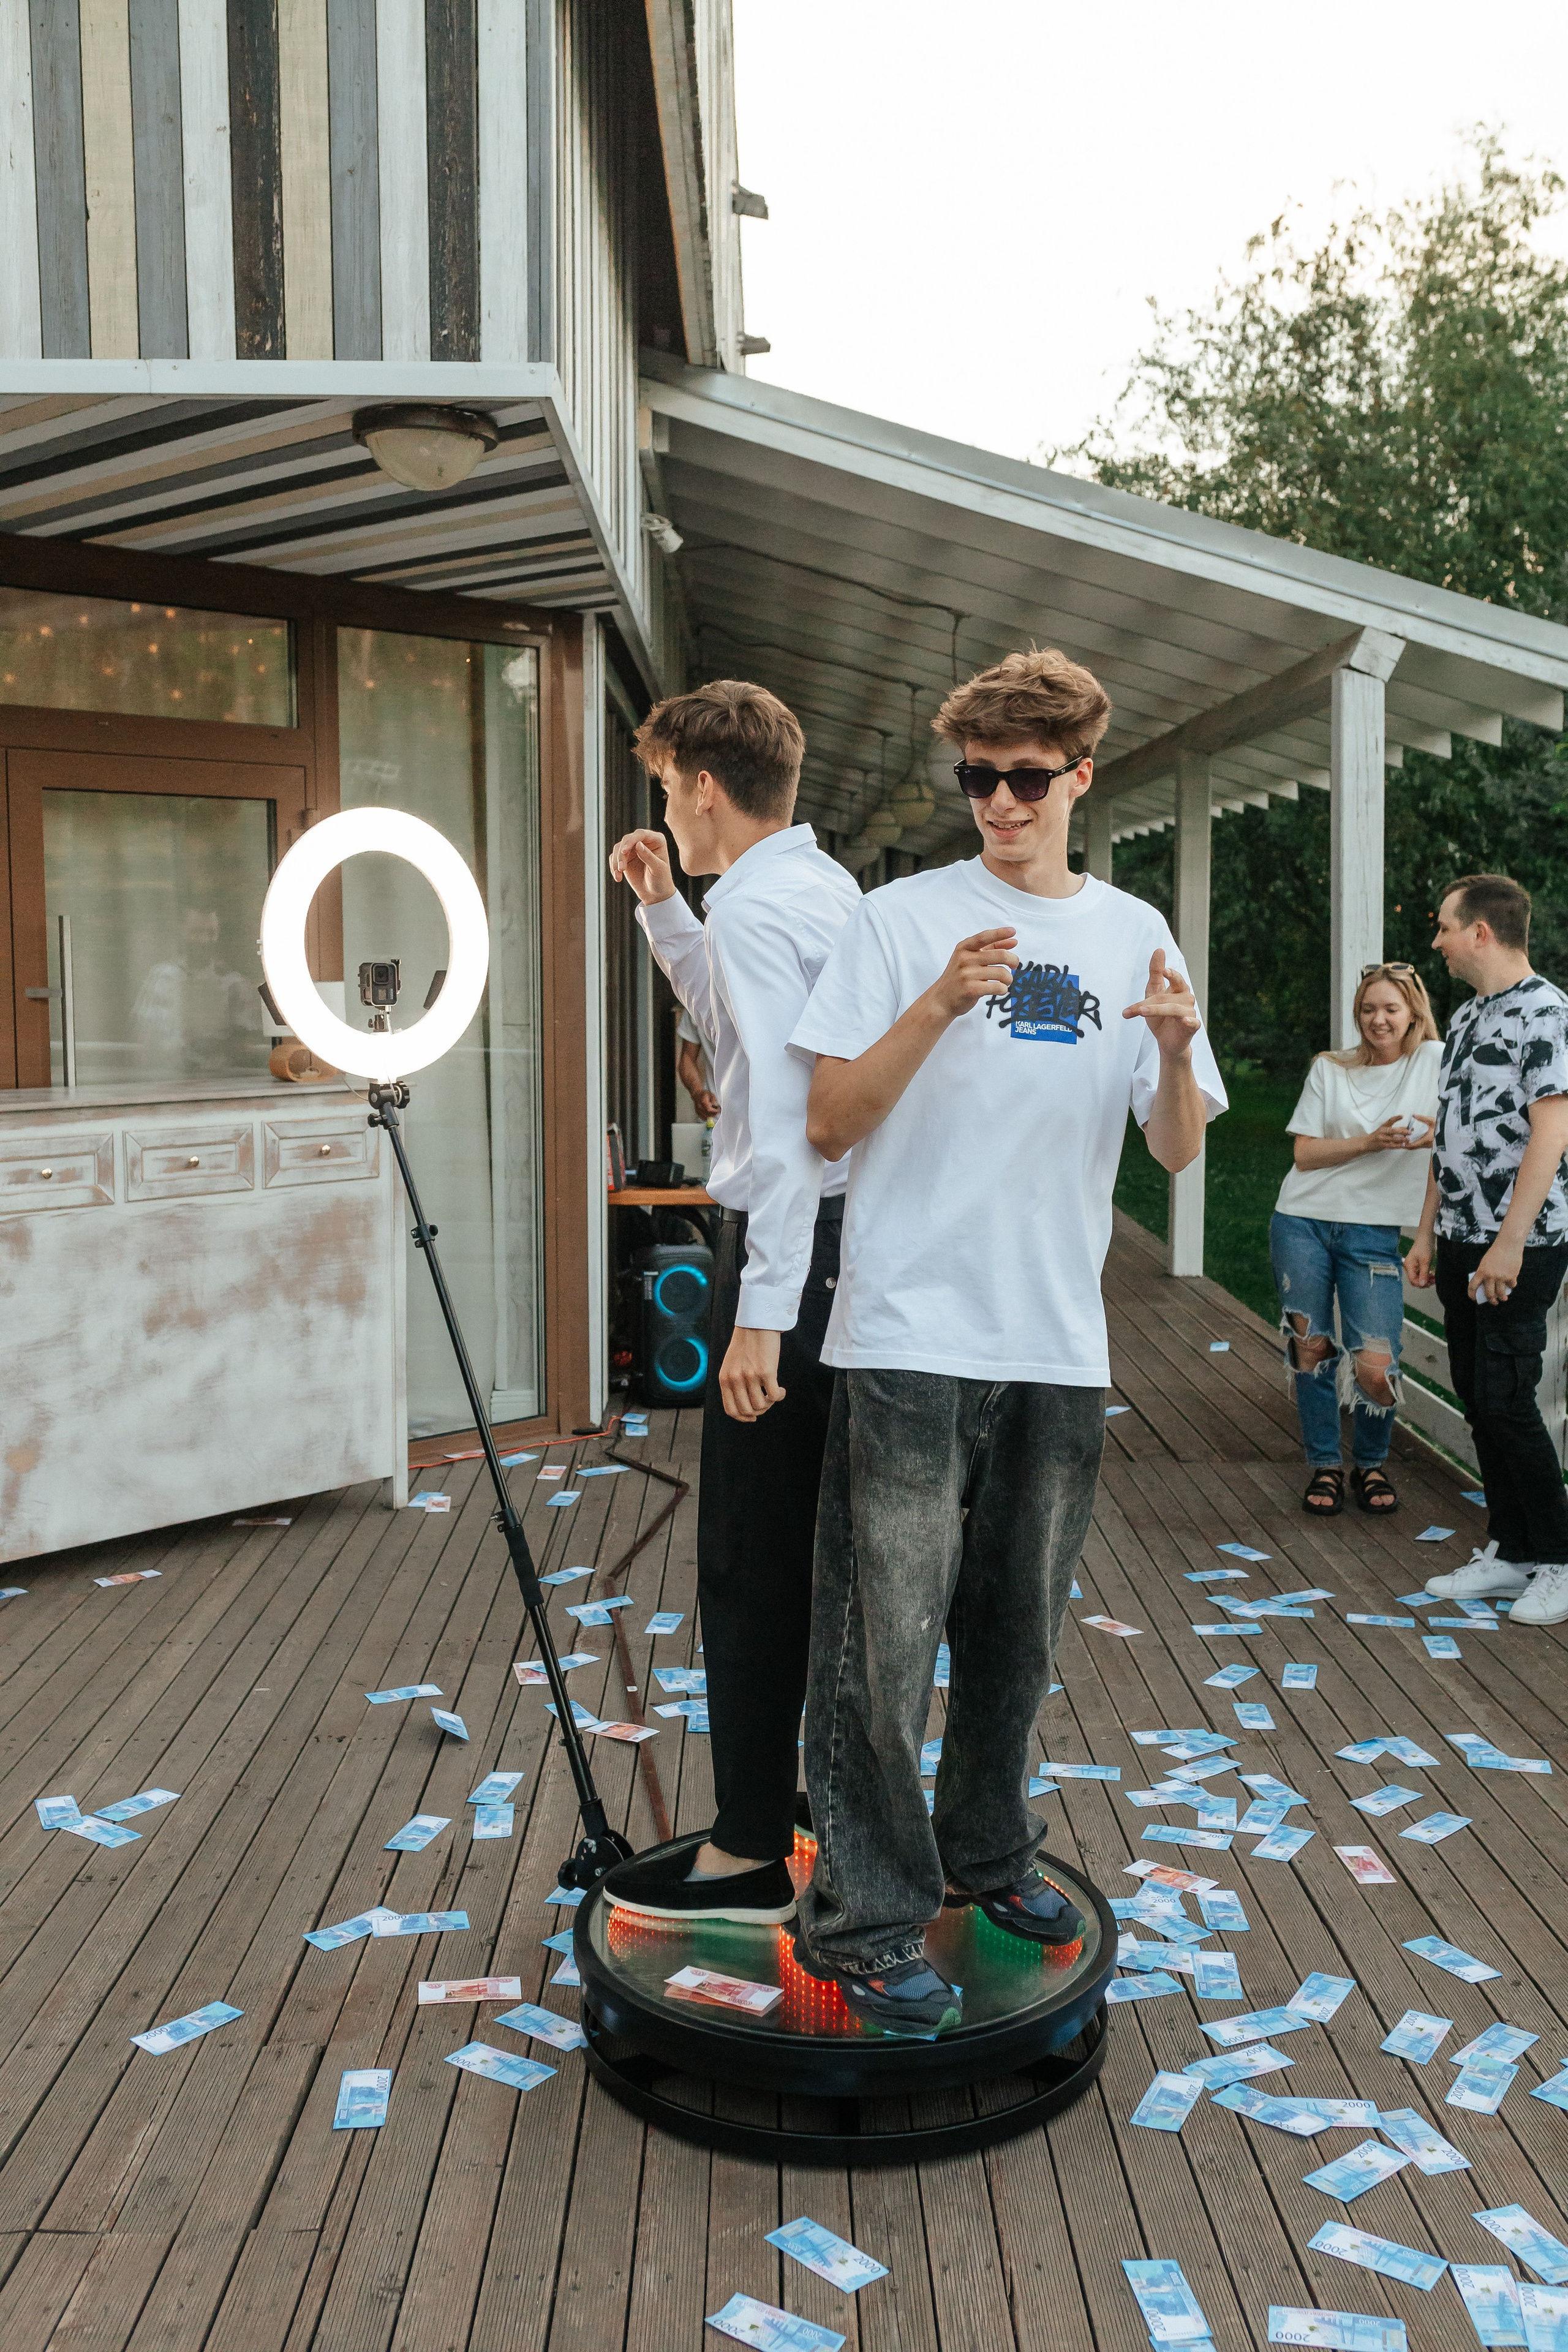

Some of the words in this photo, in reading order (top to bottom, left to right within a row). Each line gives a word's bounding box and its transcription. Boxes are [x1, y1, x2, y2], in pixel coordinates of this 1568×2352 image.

[1224, 1957, 1235, 1970] 2000
[1447, 1966, 1472, 1978] 2000
[1317, 2006, 1333, 2020] 2000
[1403, 2013, 1419, 2027] 2000
[214, 2018, 228, 2026] 2000
[145, 2027, 169, 2041] 2000
[1223, 2034, 1249, 2045] 2000
[1245, 2045, 1267, 2056] 2000
[451, 2056, 477, 2068] 2000
[375, 2075, 388, 2092] 2000
[1183, 2084, 1200, 2100] 2000
[1450, 2084, 1468, 2100] 2000
[1354, 2143, 1378, 2158] 2000
[1441, 2149, 1465, 2165] 2000
[1479, 2215, 1507, 2234] 2000
[1315, 2241, 1348, 2256] 2000
[853, 2255, 881, 2274] 2000
[1455, 2267, 1474, 2289] 2000
[1521, 2286, 1537, 2308] 2000
[1276, 2331, 1310, 2342] 2000
